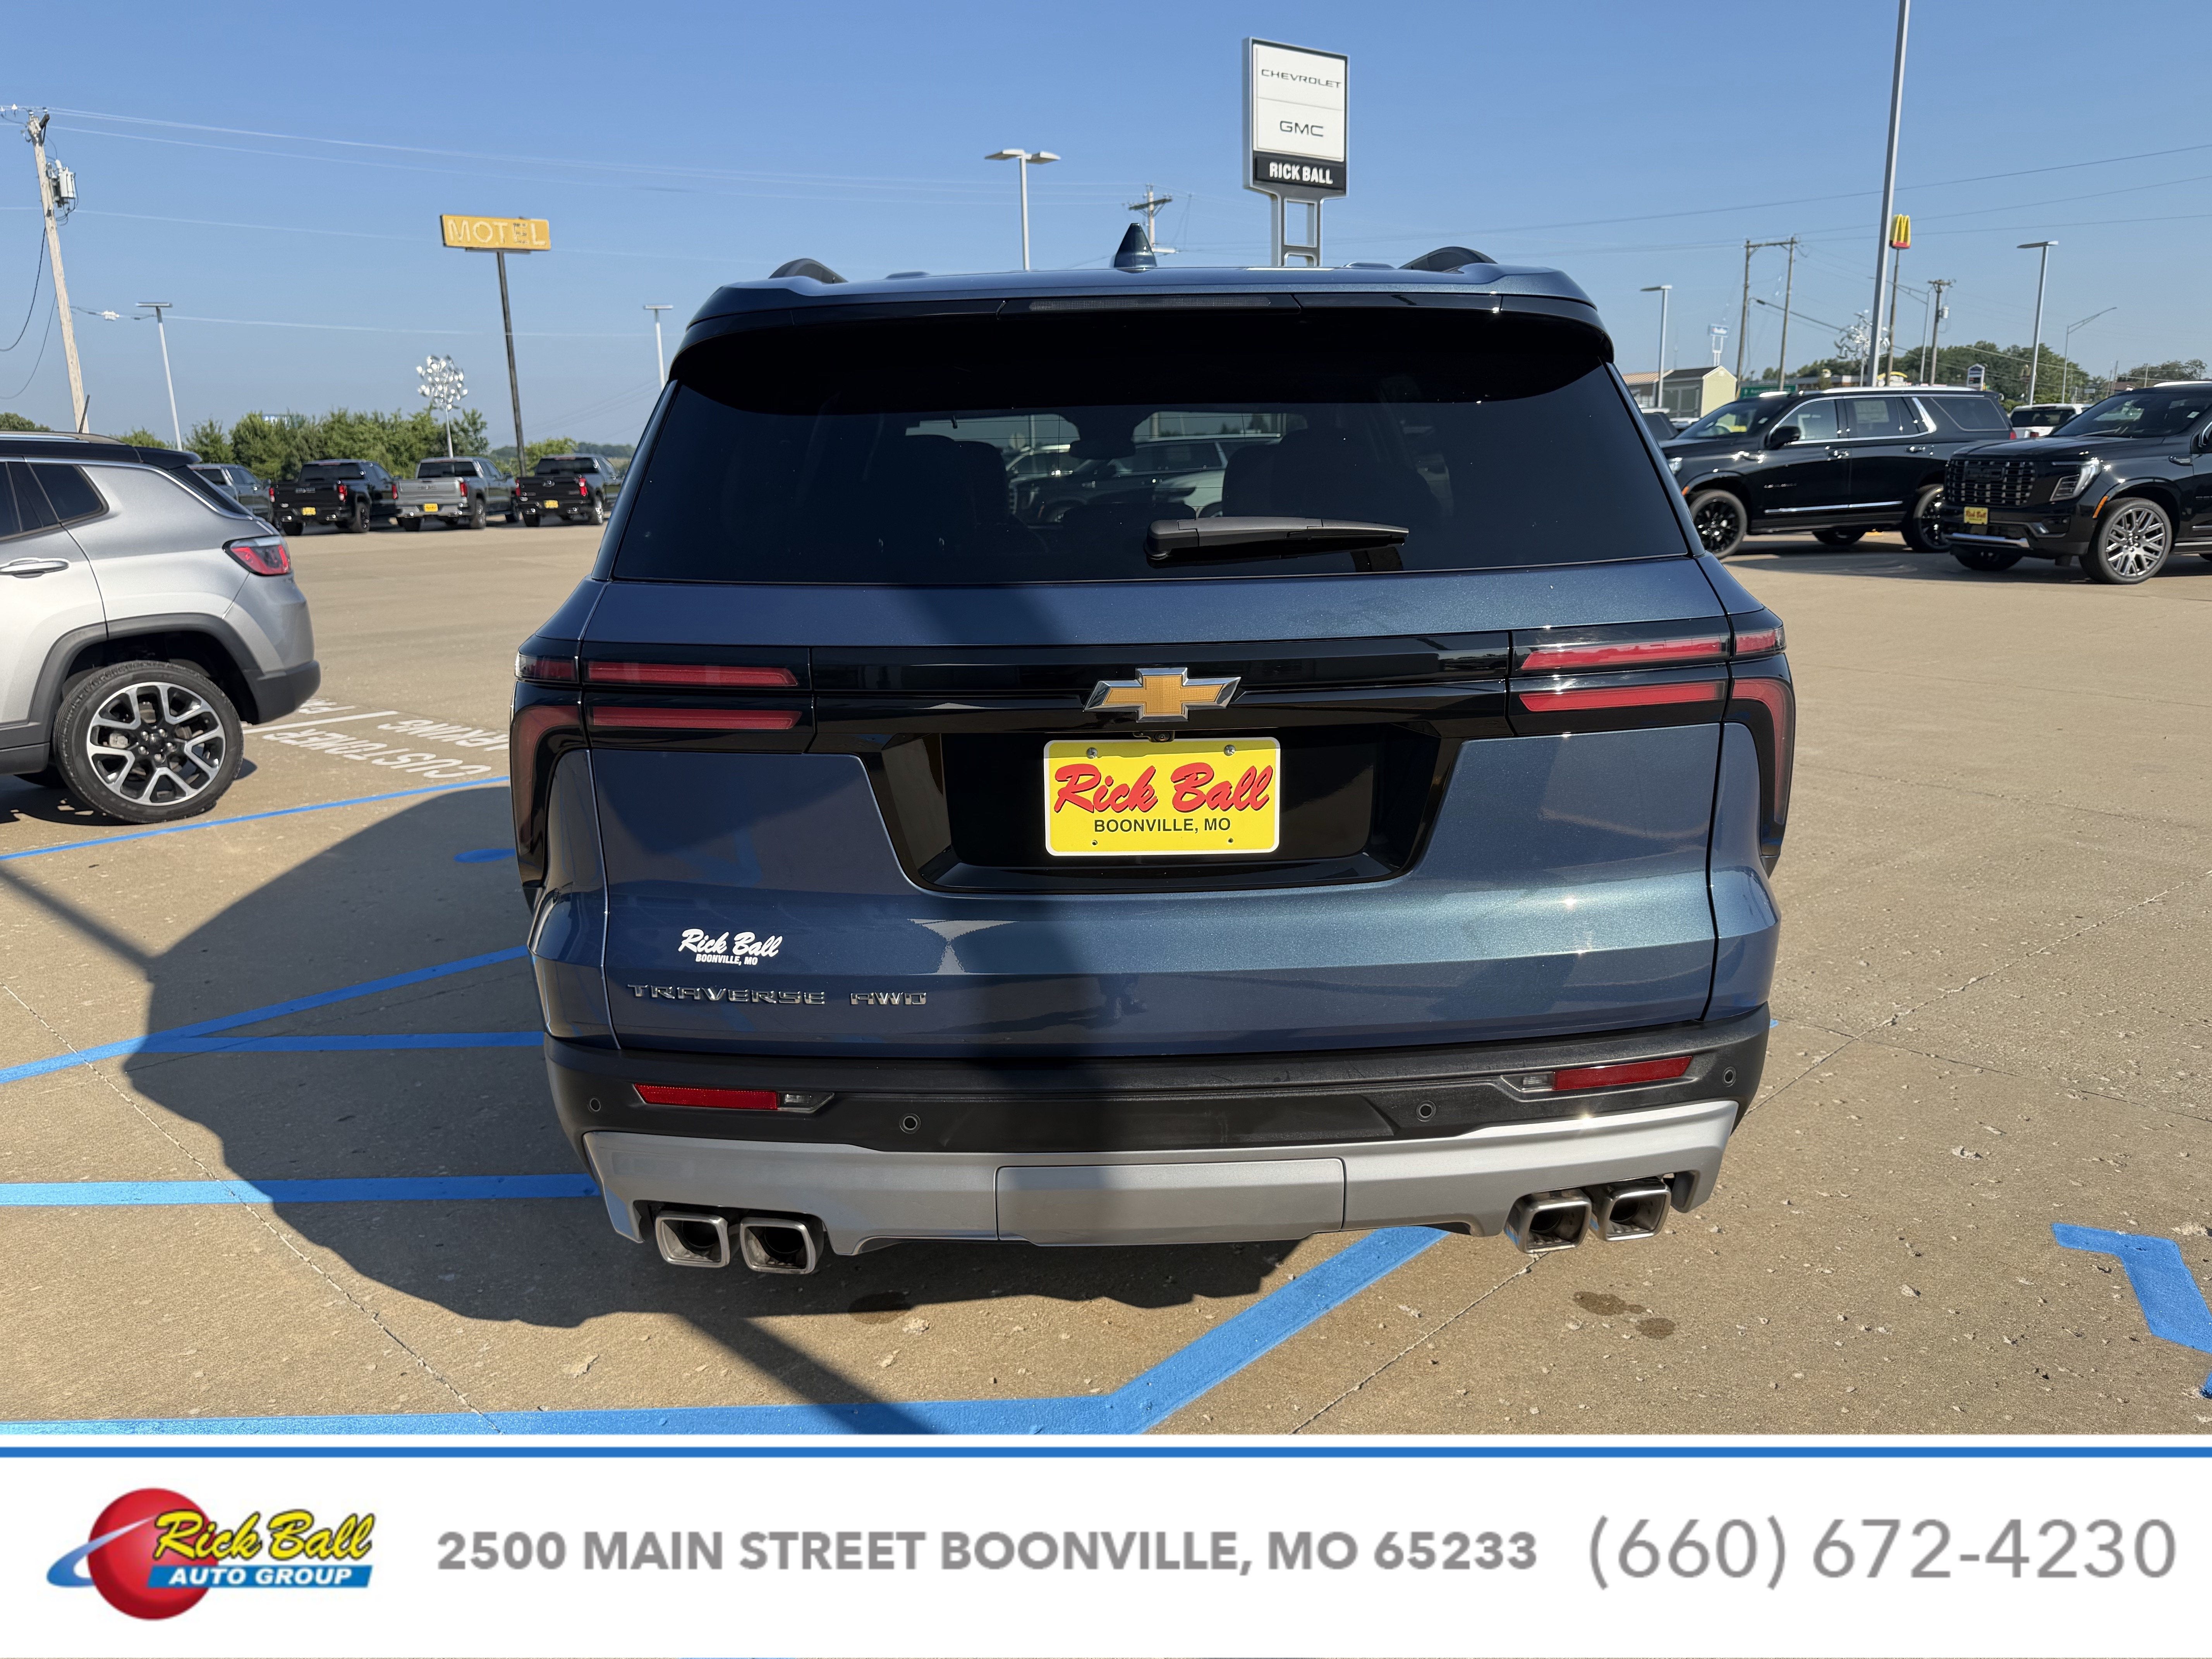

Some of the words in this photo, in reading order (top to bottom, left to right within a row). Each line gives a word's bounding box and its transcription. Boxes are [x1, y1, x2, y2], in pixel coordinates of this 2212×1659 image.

[1261, 69, 1342, 88] CHEVROLET
[1279, 120, 1324, 137] GMC
[1269, 162, 1301, 181] RICK
[1302, 165, 1333, 185] BALL
[447, 219, 546, 246] MOTEL
[1054, 763, 1158, 813] Rick
[1170, 762, 1273, 813] Ball
[1094, 818, 1199, 834] BOONVILLE,
[1204, 817, 1231, 831] MO
[678, 928, 729, 954] Rick
[732, 931, 783, 957] Ball
[695, 953, 742, 966] BOONVILLE,
[744, 956, 758, 965] MO
[627, 984, 826, 1005] TRAVERSE
[850, 991, 927, 1006] AWD
